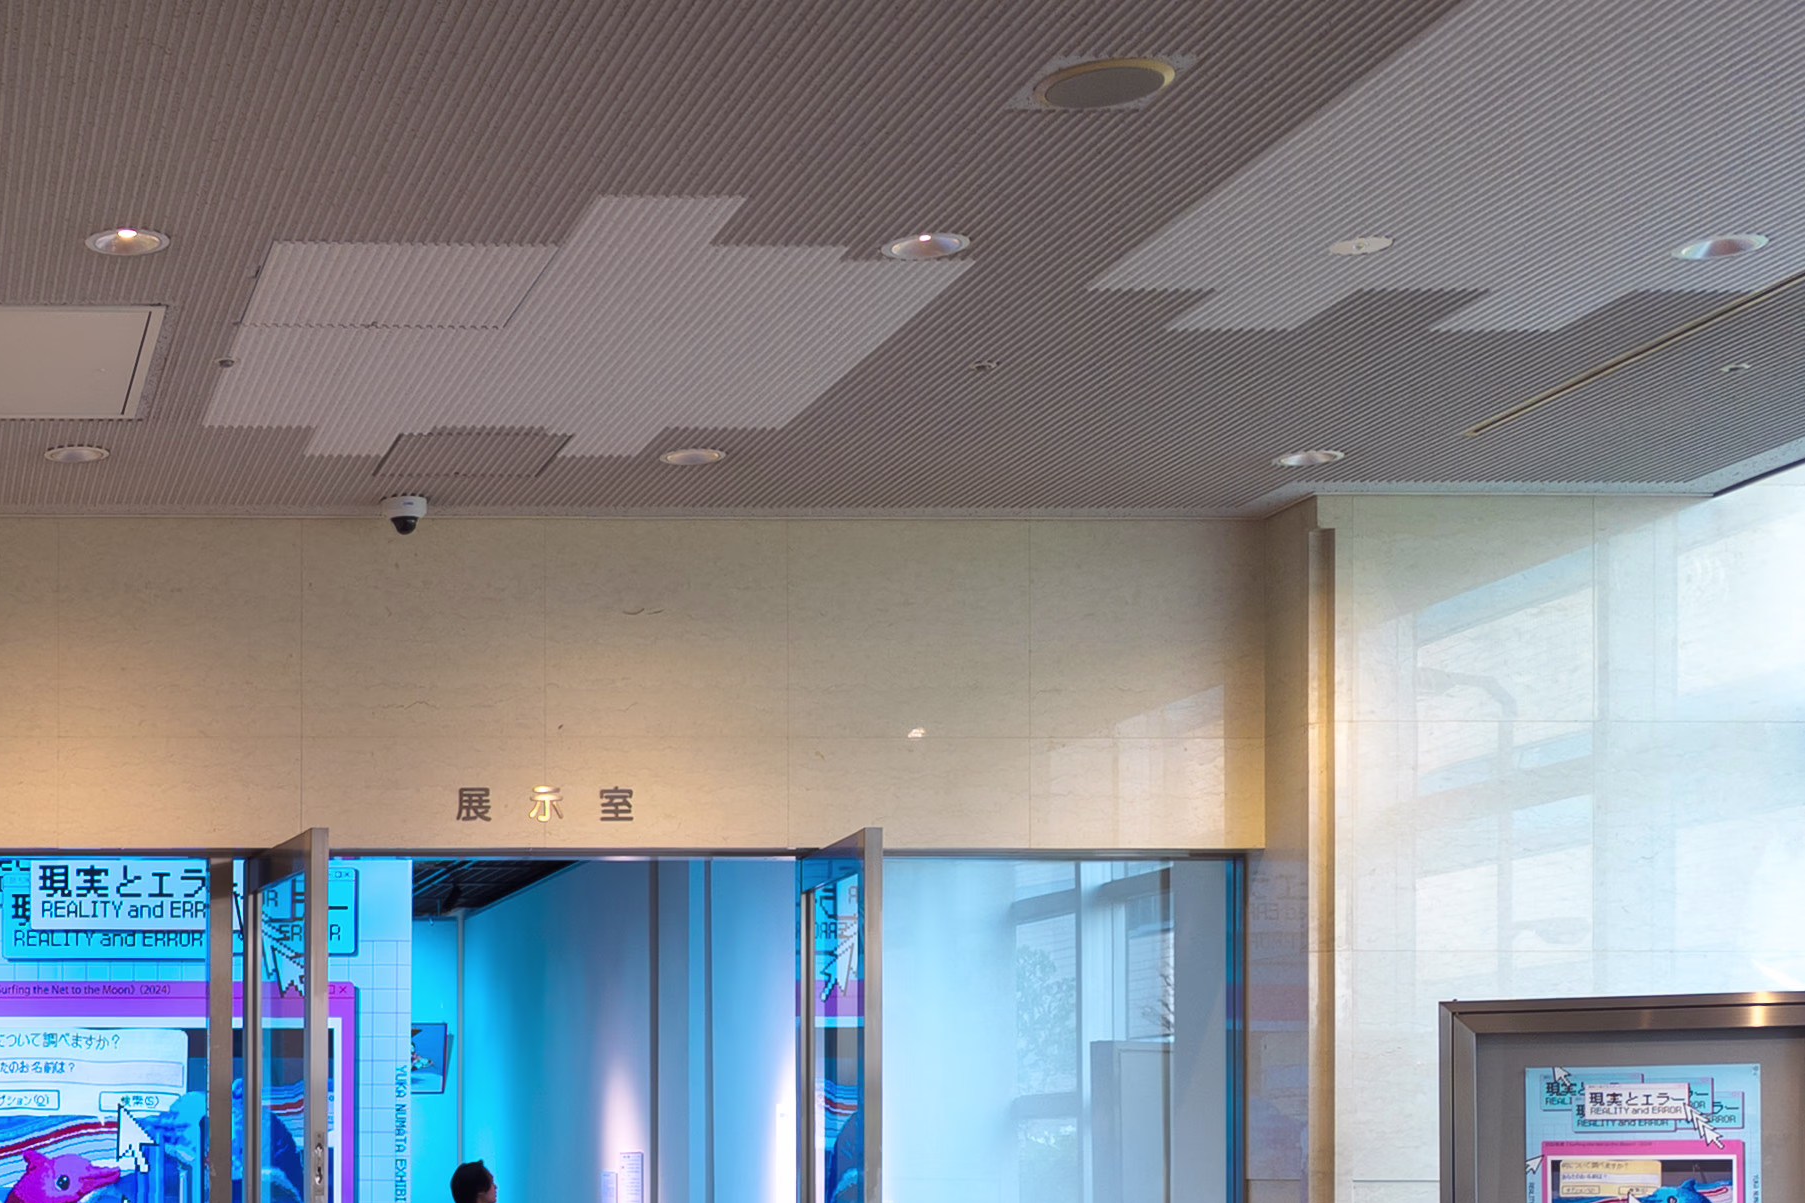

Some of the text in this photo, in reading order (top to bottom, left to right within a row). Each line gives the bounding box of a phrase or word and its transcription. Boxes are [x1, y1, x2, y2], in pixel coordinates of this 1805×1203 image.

[456, 785, 634, 822] 展示室
[39, 865, 206, 898] 現実とエラ
[41, 901, 123, 919] REALITY
[127, 901, 165, 919] and
[170, 901, 206, 919] ERR
[13, 930, 204, 947] REALITY and ERROR
[35, 984, 52, 995] the
[54, 984, 71, 995] Net
[73, 985, 82, 995] to
[84, 984, 100, 995] the
[395, 1064, 407, 1098] YUKA
[1589, 1091, 1685, 1106] 現実とエラー
[1590, 1105, 1683, 1115] REALITY and ERROR
[395, 1103, 407, 1153] NUMATA
